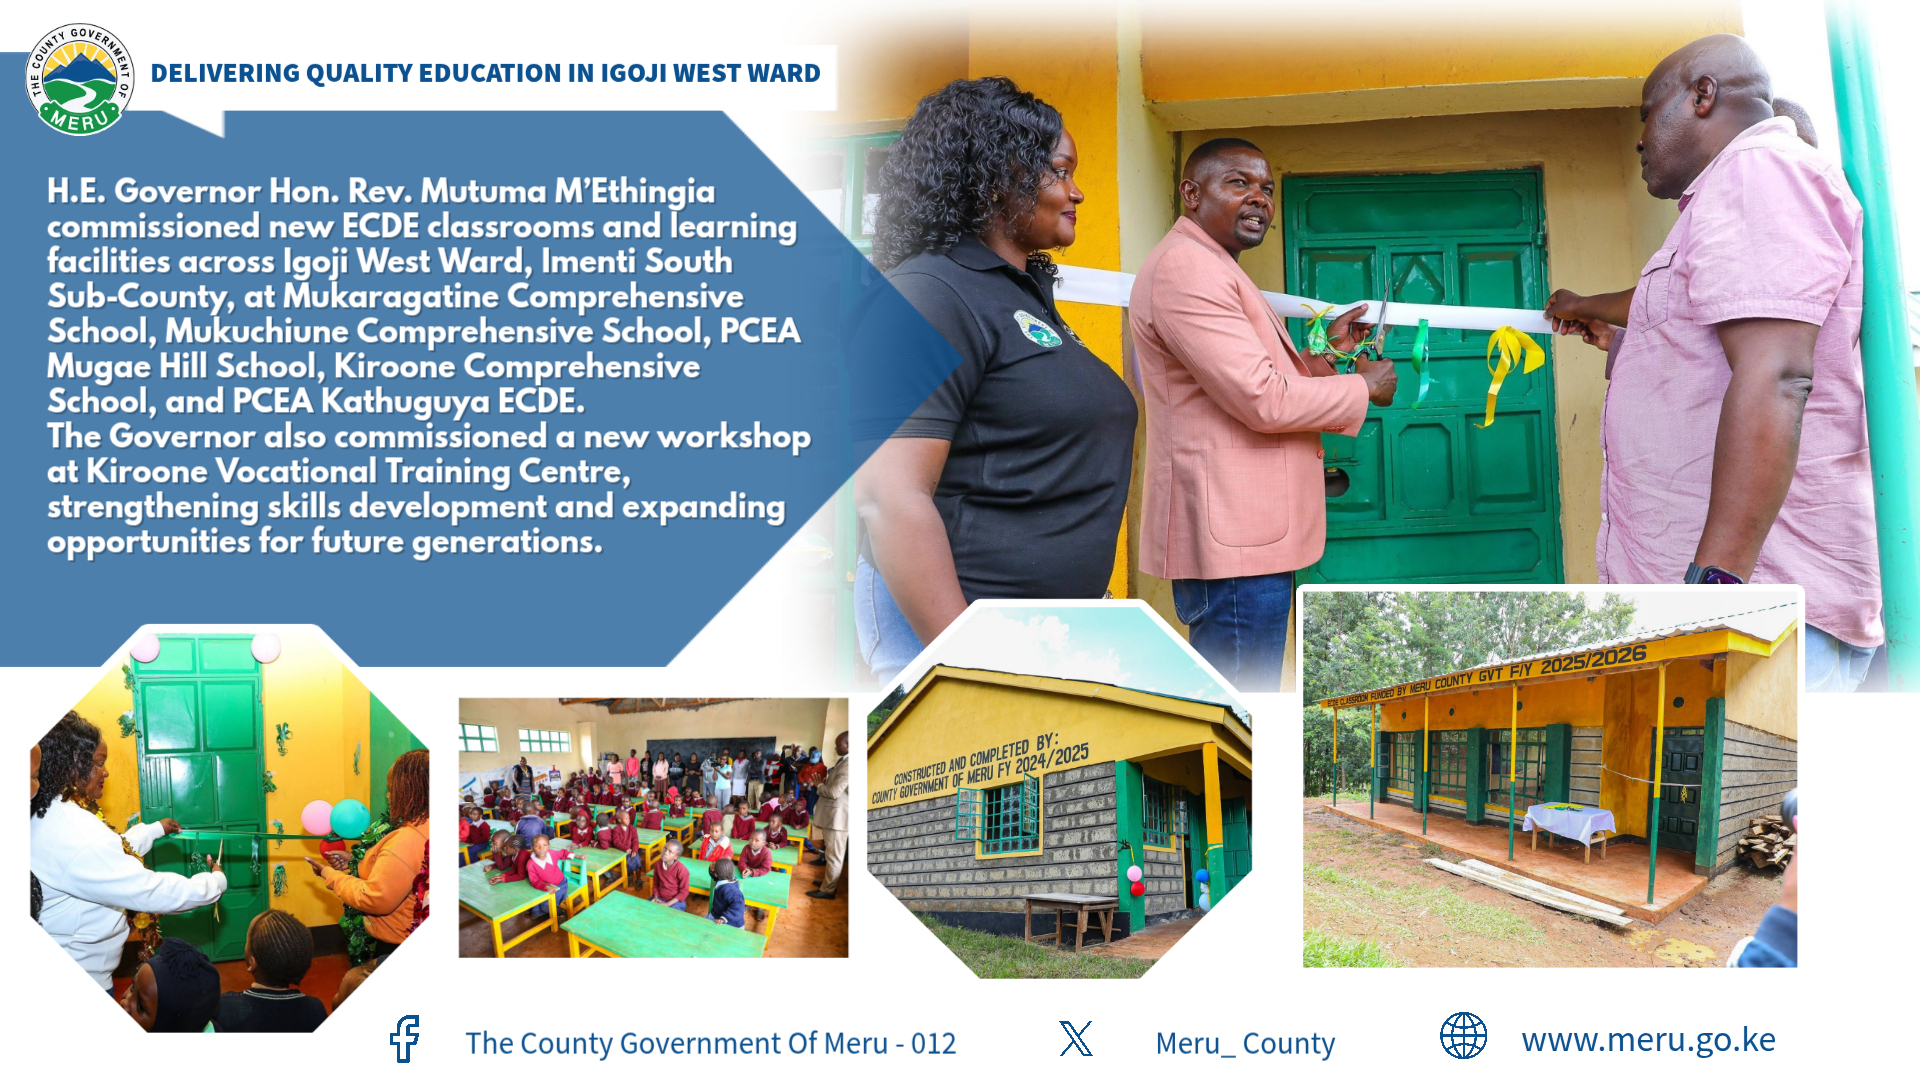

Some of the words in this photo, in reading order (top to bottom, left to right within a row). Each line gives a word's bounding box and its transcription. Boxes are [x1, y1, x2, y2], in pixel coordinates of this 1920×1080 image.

[1397, 686, 1407, 696] BY
[1410, 681, 1431, 694] MERU
[1435, 672, 1473, 689] COUNTY
[1479, 668, 1503, 682] GVT
[1510, 663, 1533, 678] F/Y
[1541, 645, 1647, 675] 2025/2026
[872, 788, 898, 805] COUNTY
[900, 775, 949, 799] GOVERNMENT
[952, 772, 964, 788] OF
[967, 765, 993, 785] MERU
[998, 761, 1012, 779] FY
[1016, 742, 1089, 775] 2024/2025
[894, 761, 946, 786] CONSTRUCTED
[949, 756, 966, 773] AND
[970, 739, 1029, 767] COMPLETED
[1037, 732, 1059, 751] BY:
